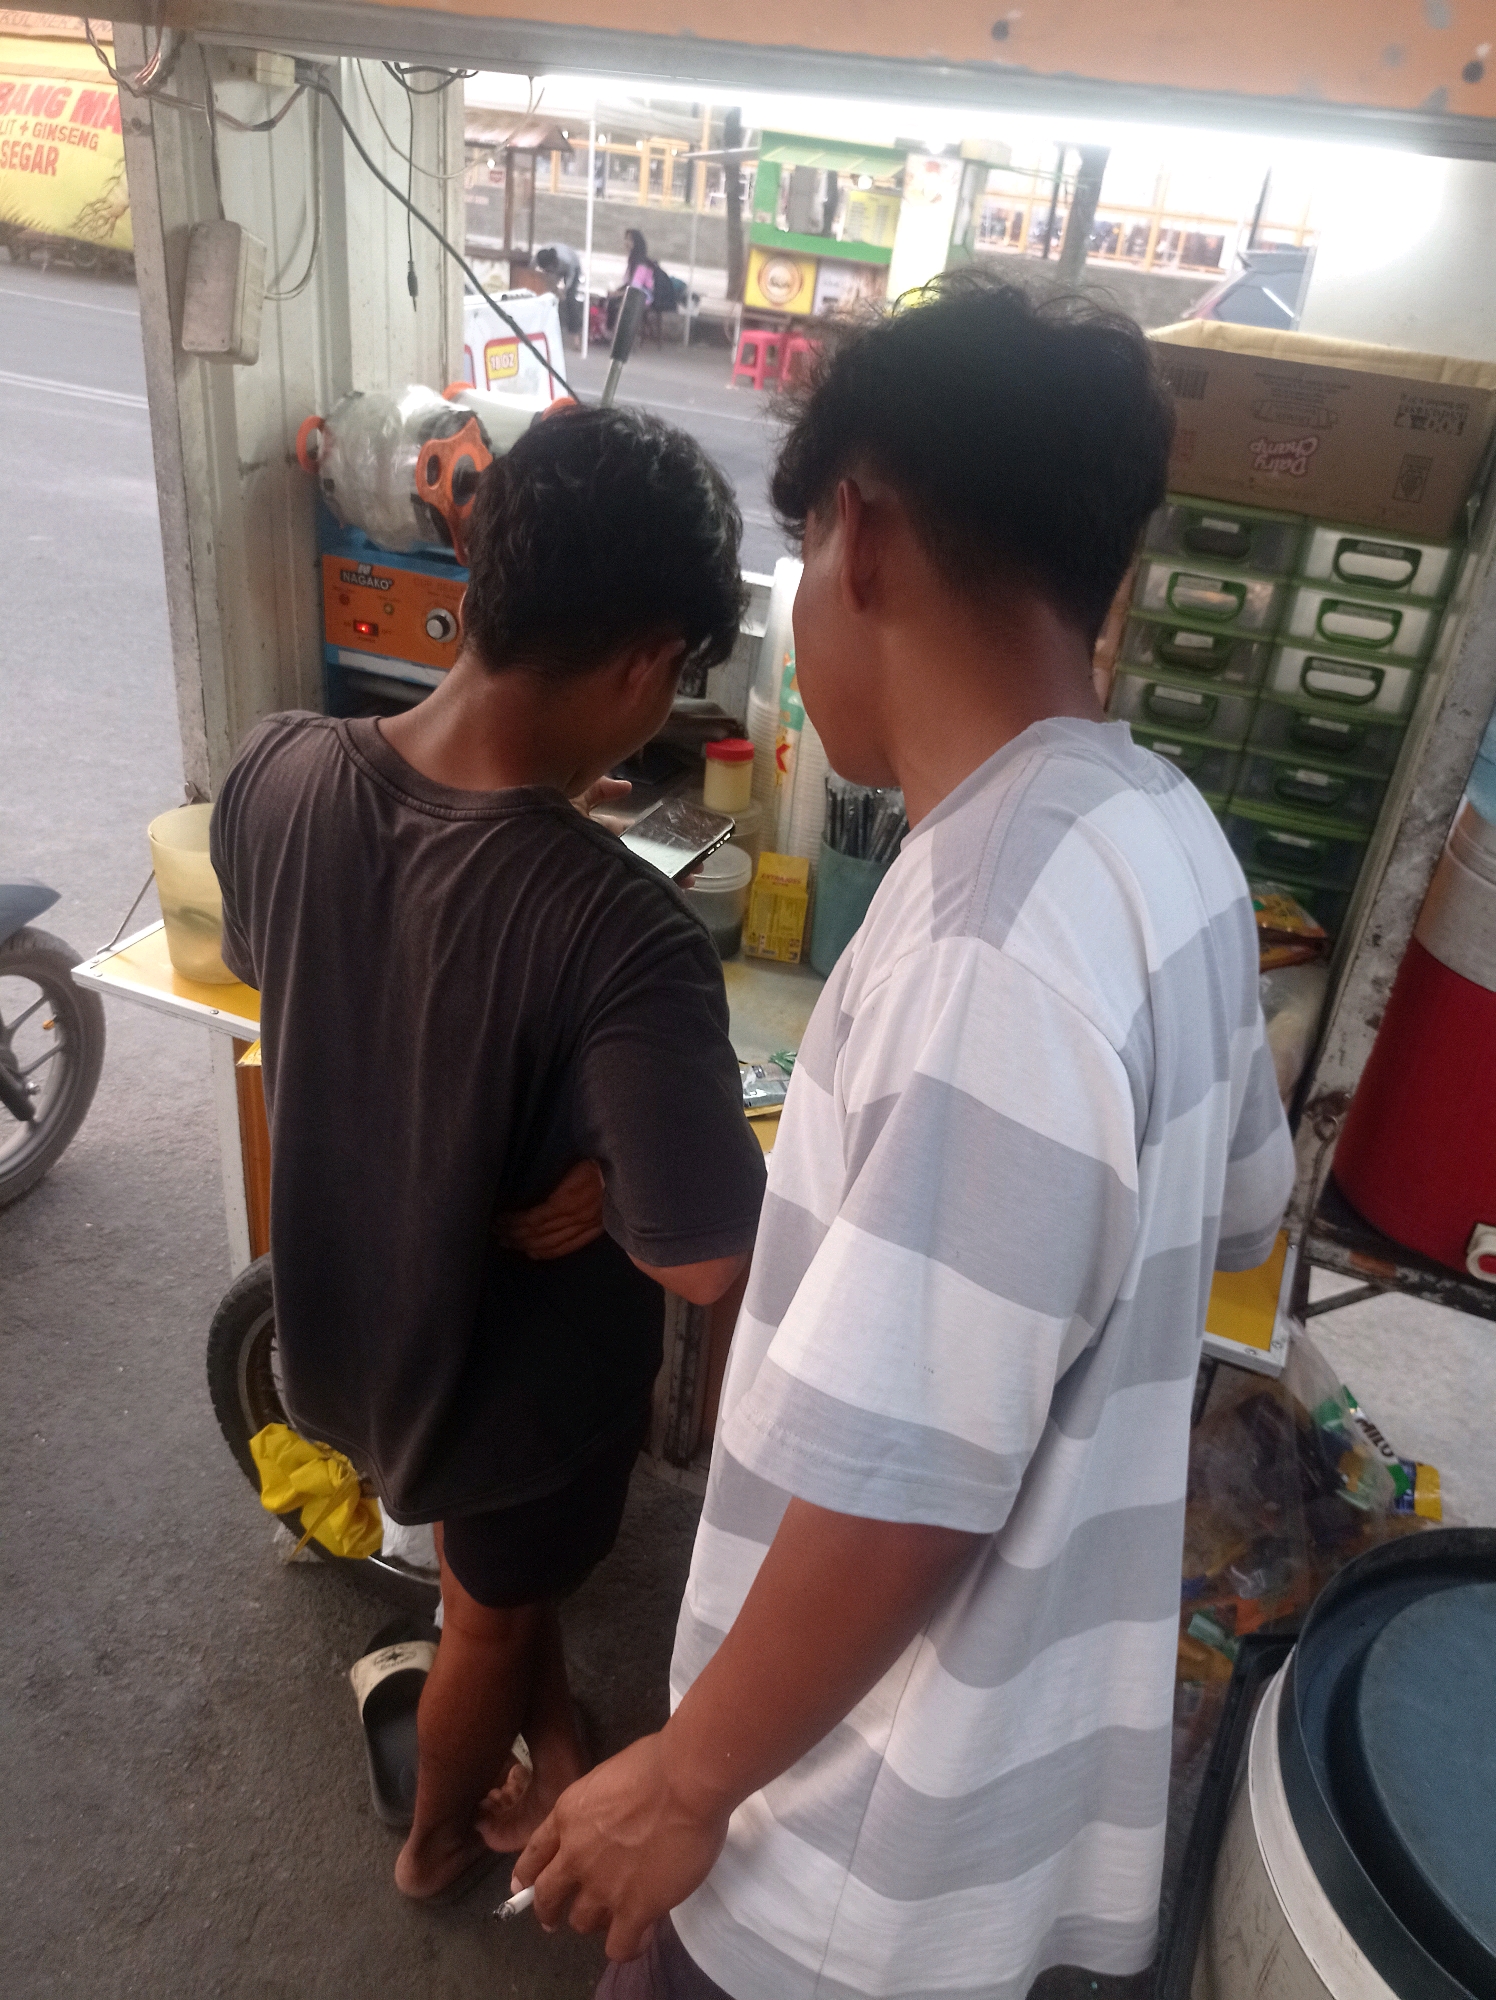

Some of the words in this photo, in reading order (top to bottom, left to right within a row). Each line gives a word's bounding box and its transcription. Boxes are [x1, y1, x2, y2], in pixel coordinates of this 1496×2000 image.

[32, 121, 100, 152] GINSENG
[0, 139, 60, 176] SEGAR
[1249, 437, 1319, 459] Champ
[1254, 455, 1308, 477] Dairy
[342, 571, 390, 591] NAGAKO
